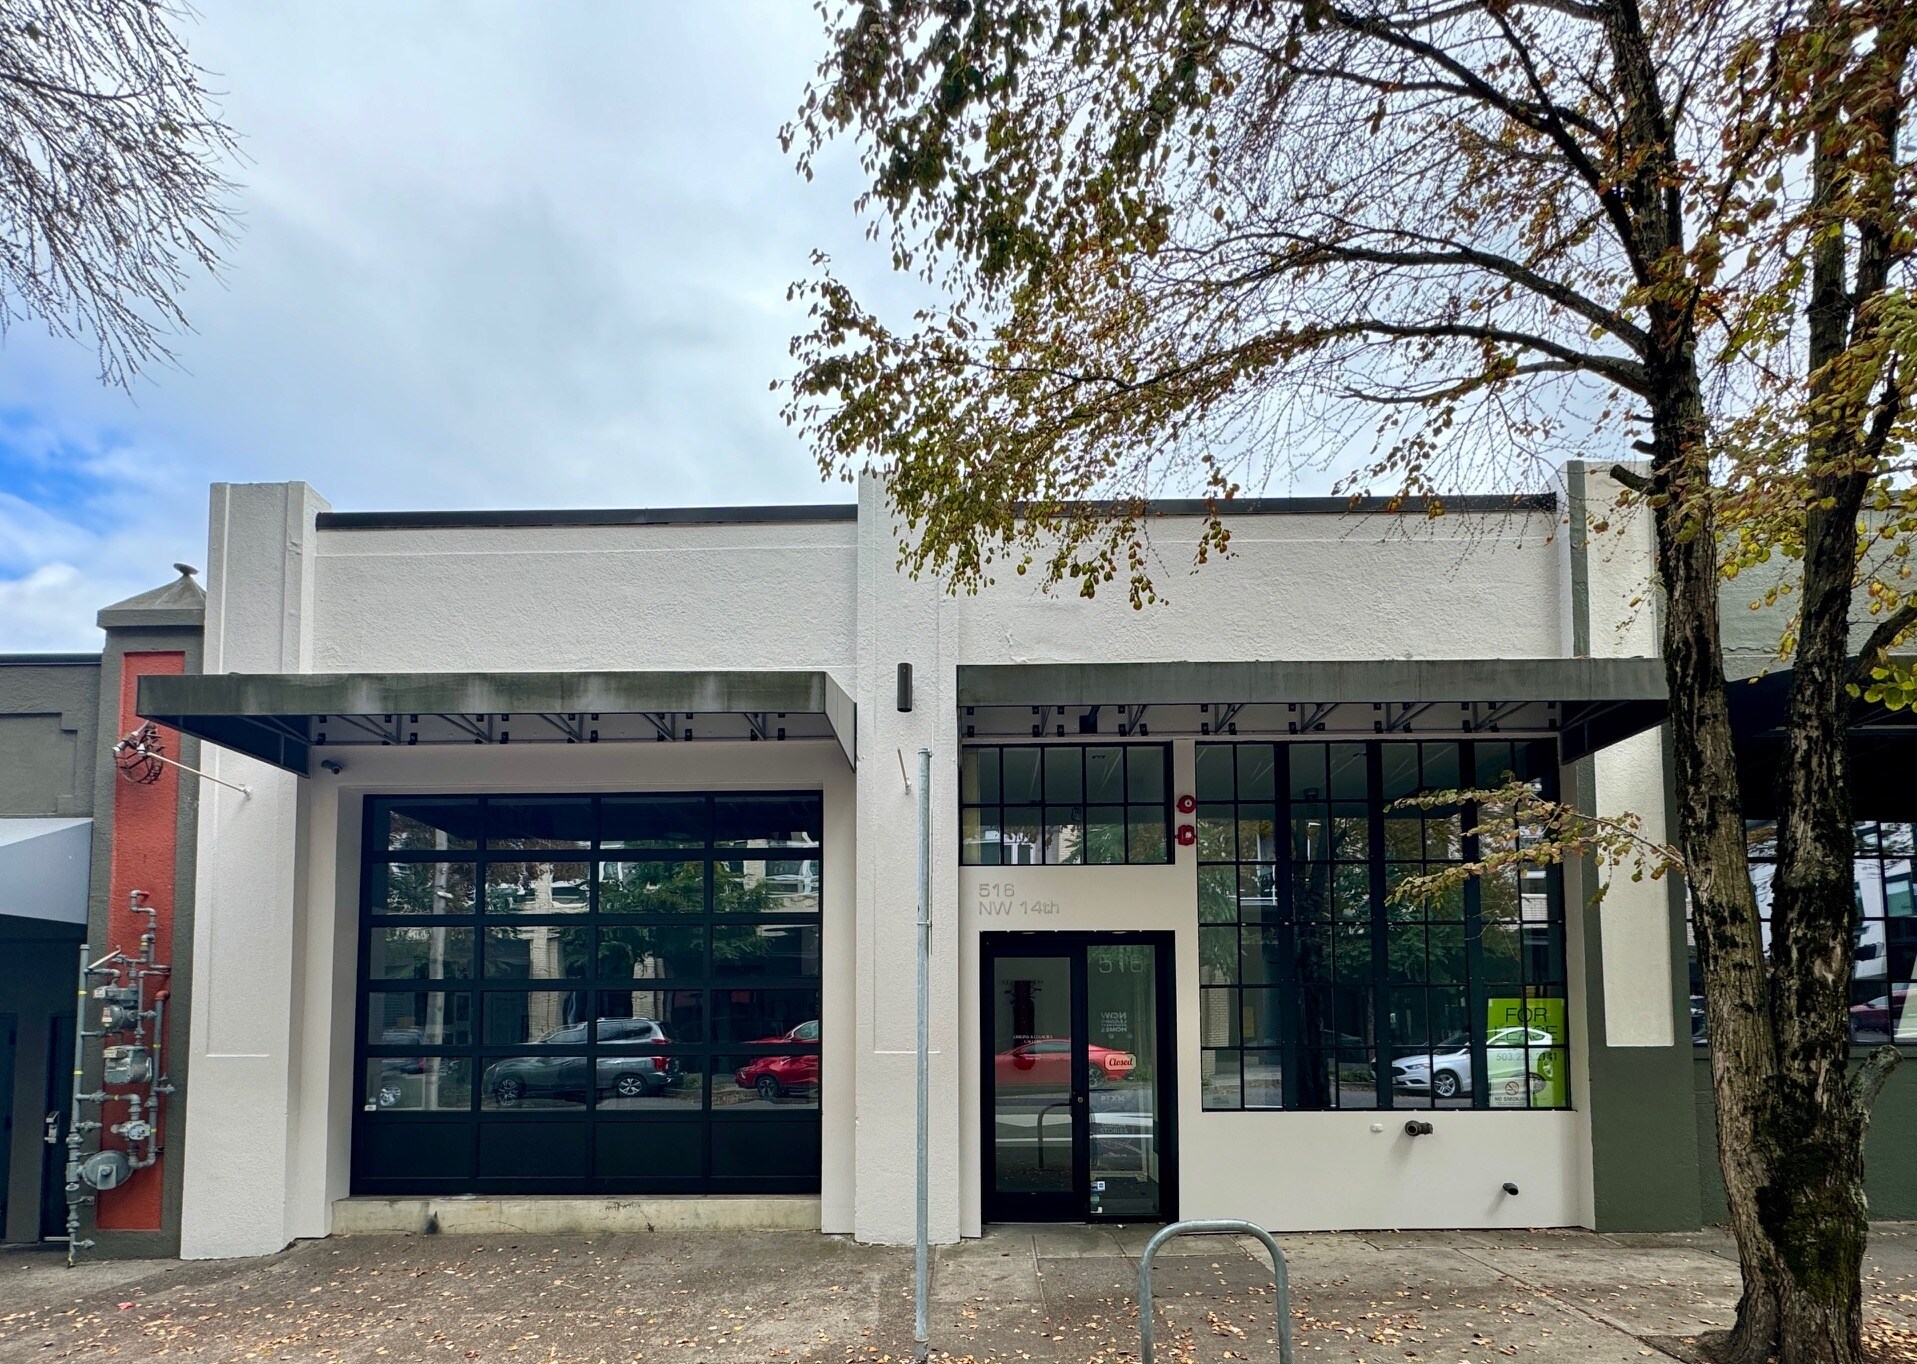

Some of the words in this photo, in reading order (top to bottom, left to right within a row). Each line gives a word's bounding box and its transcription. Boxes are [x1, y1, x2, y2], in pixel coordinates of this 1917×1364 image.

[978, 883, 1015, 897] 516
[978, 900, 1013, 915] NW
[1019, 900, 1060, 914] 14th
[1505, 1007, 1547, 1023] FOR
[1108, 1057, 1134, 1067] Closed
